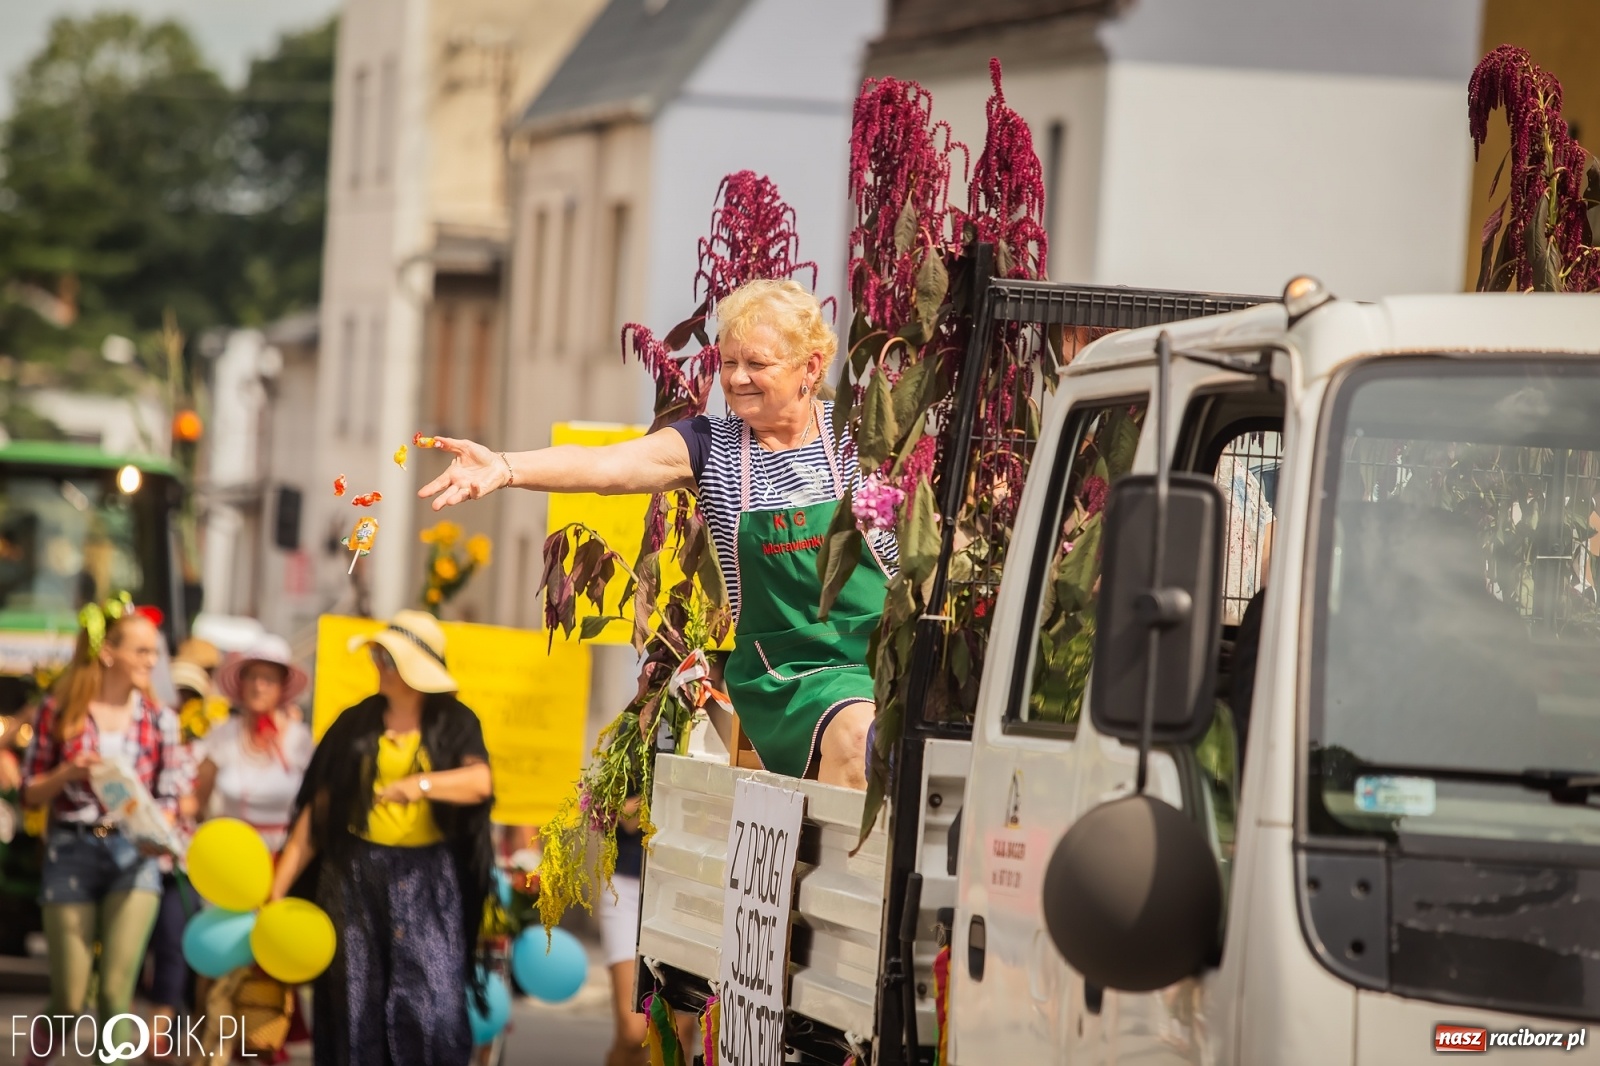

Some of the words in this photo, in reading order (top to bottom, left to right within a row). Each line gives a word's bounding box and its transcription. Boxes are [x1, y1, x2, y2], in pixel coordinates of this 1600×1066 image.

[773, 513, 787, 531] K
[793, 511, 805, 526] G
[729, 820, 745, 889] Z
[744, 822, 788, 907] DROGI
